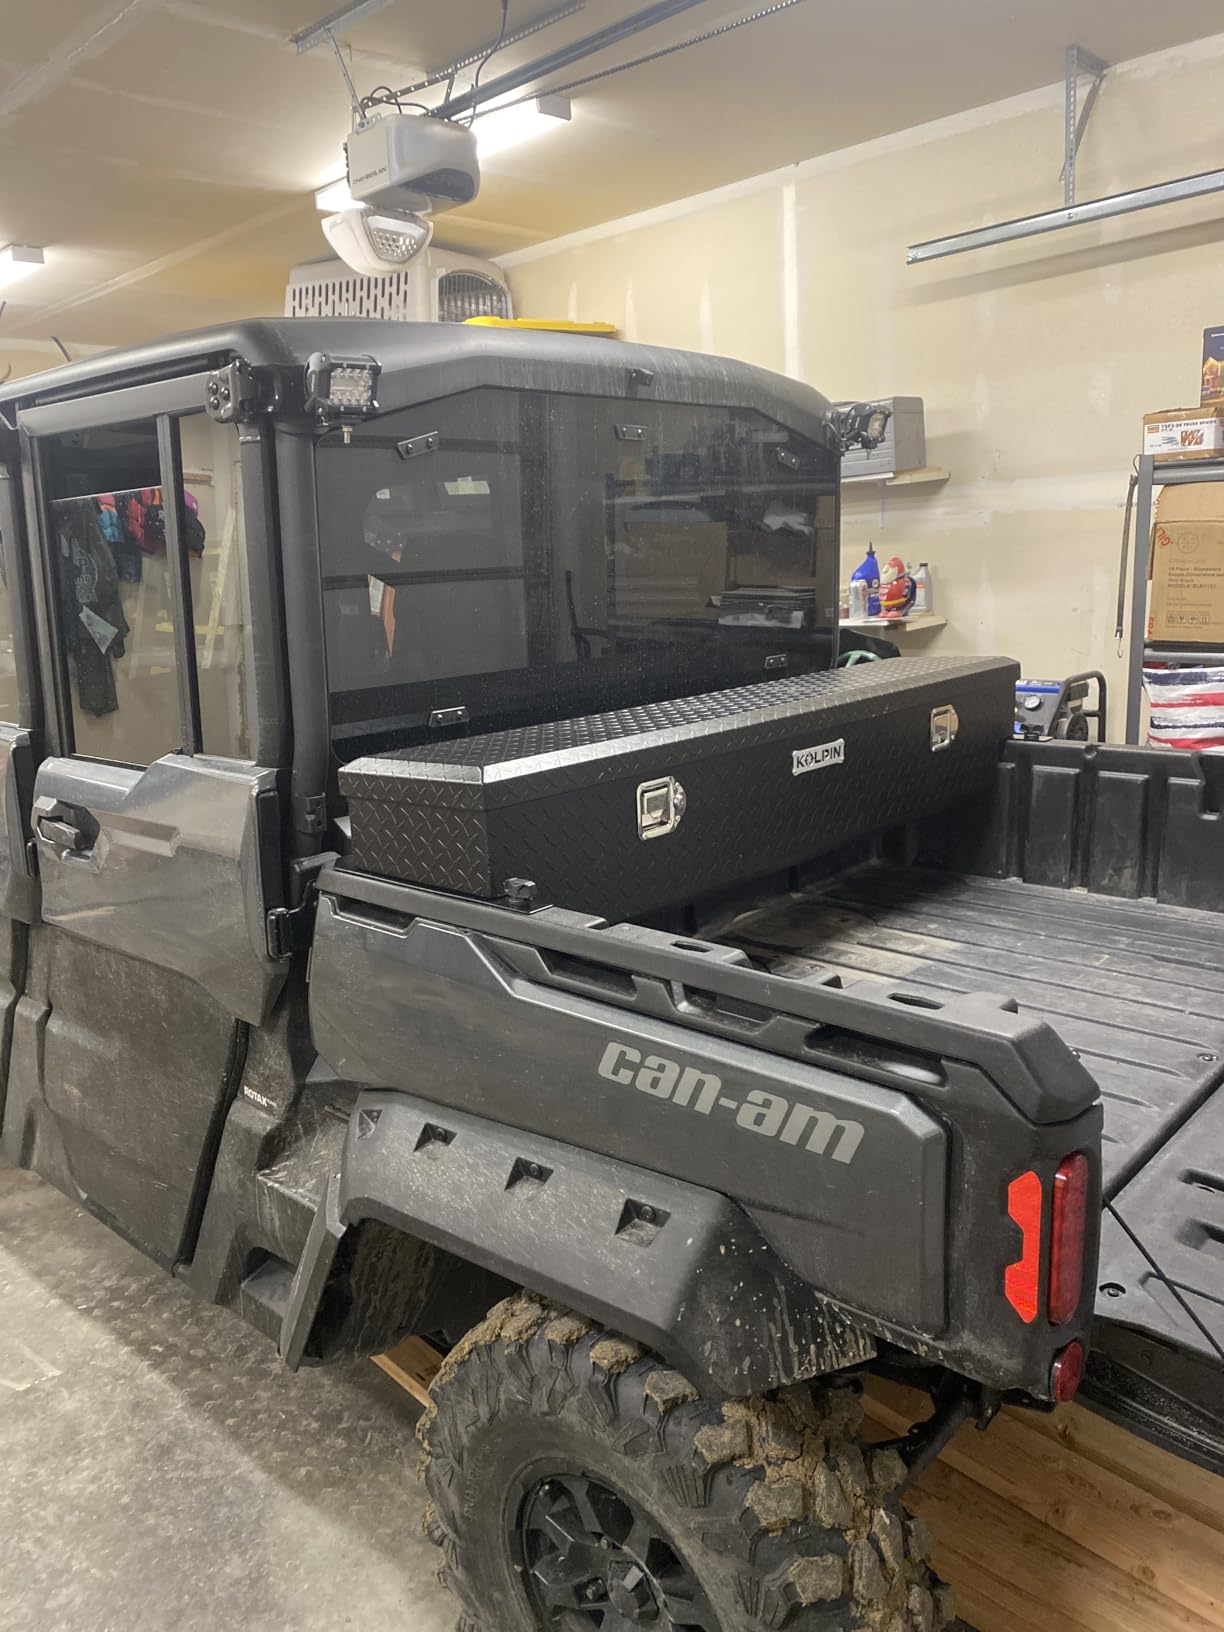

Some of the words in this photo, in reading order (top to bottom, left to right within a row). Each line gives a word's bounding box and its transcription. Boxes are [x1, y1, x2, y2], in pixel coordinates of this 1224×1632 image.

[796, 745, 841, 769] KOLPIN
[243, 1085, 268, 1107] ROTAX
[598, 1041, 865, 1164] can-am
